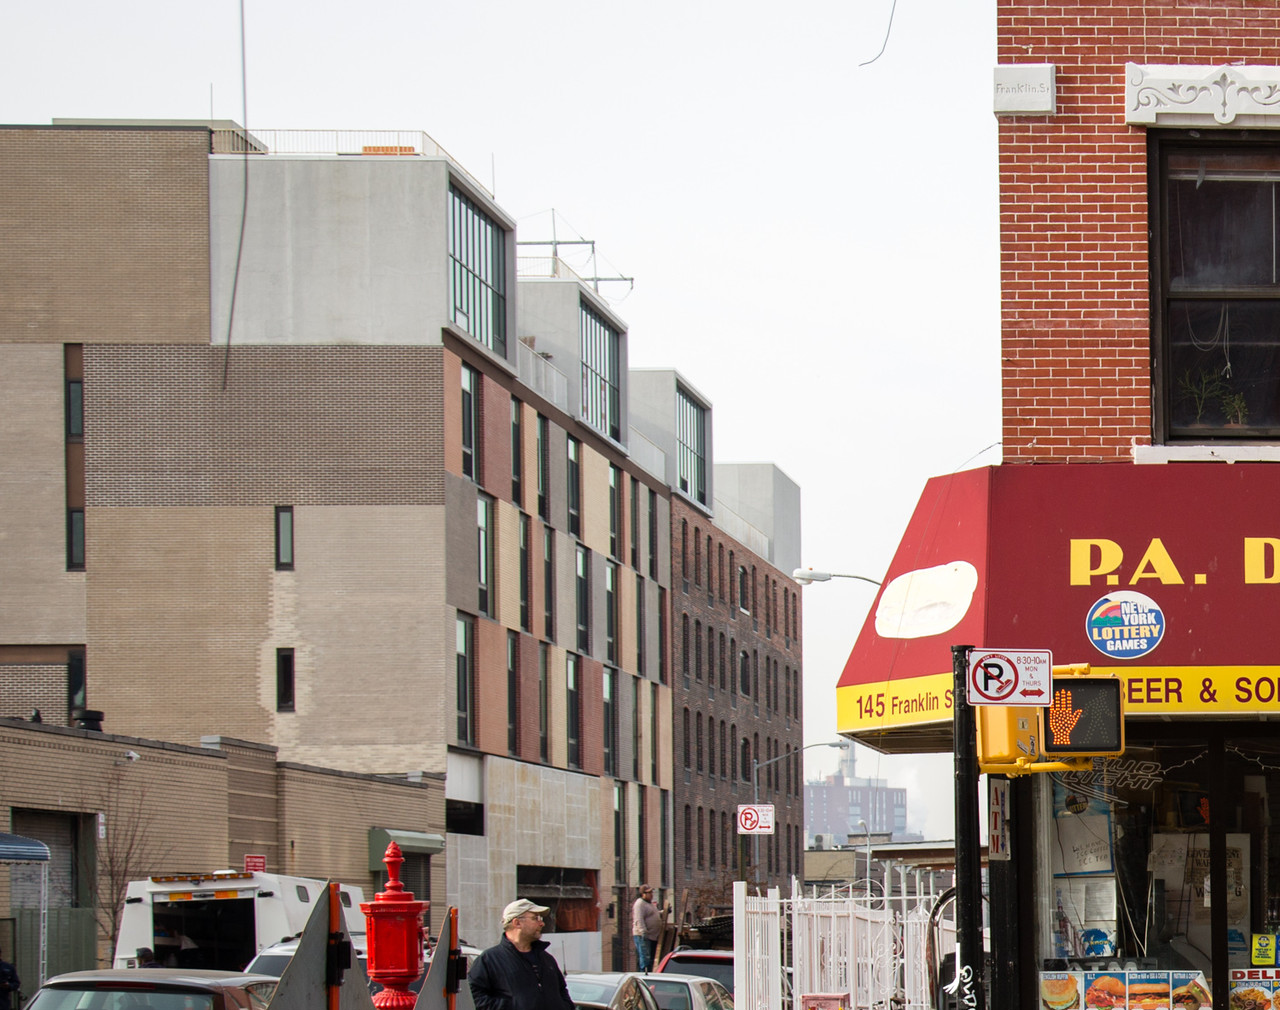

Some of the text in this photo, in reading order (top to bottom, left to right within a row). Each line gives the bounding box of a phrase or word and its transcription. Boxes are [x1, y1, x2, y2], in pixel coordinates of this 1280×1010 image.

[1122, 612, 1157, 626] YORK
[1092, 625, 1160, 641] LOTTERY
[1106, 638, 1147, 651] GAMES
[1022, 680, 1042, 690] THURS
[1121, 677, 1183, 704] EER
[1199, 677, 1218, 704] &
[857, 689, 955, 720] 145 Franklin S
[1062, 770, 1164, 790] LIGHT
[991, 787, 1000, 854] ATM
[1231, 969, 1280, 980] DELI
